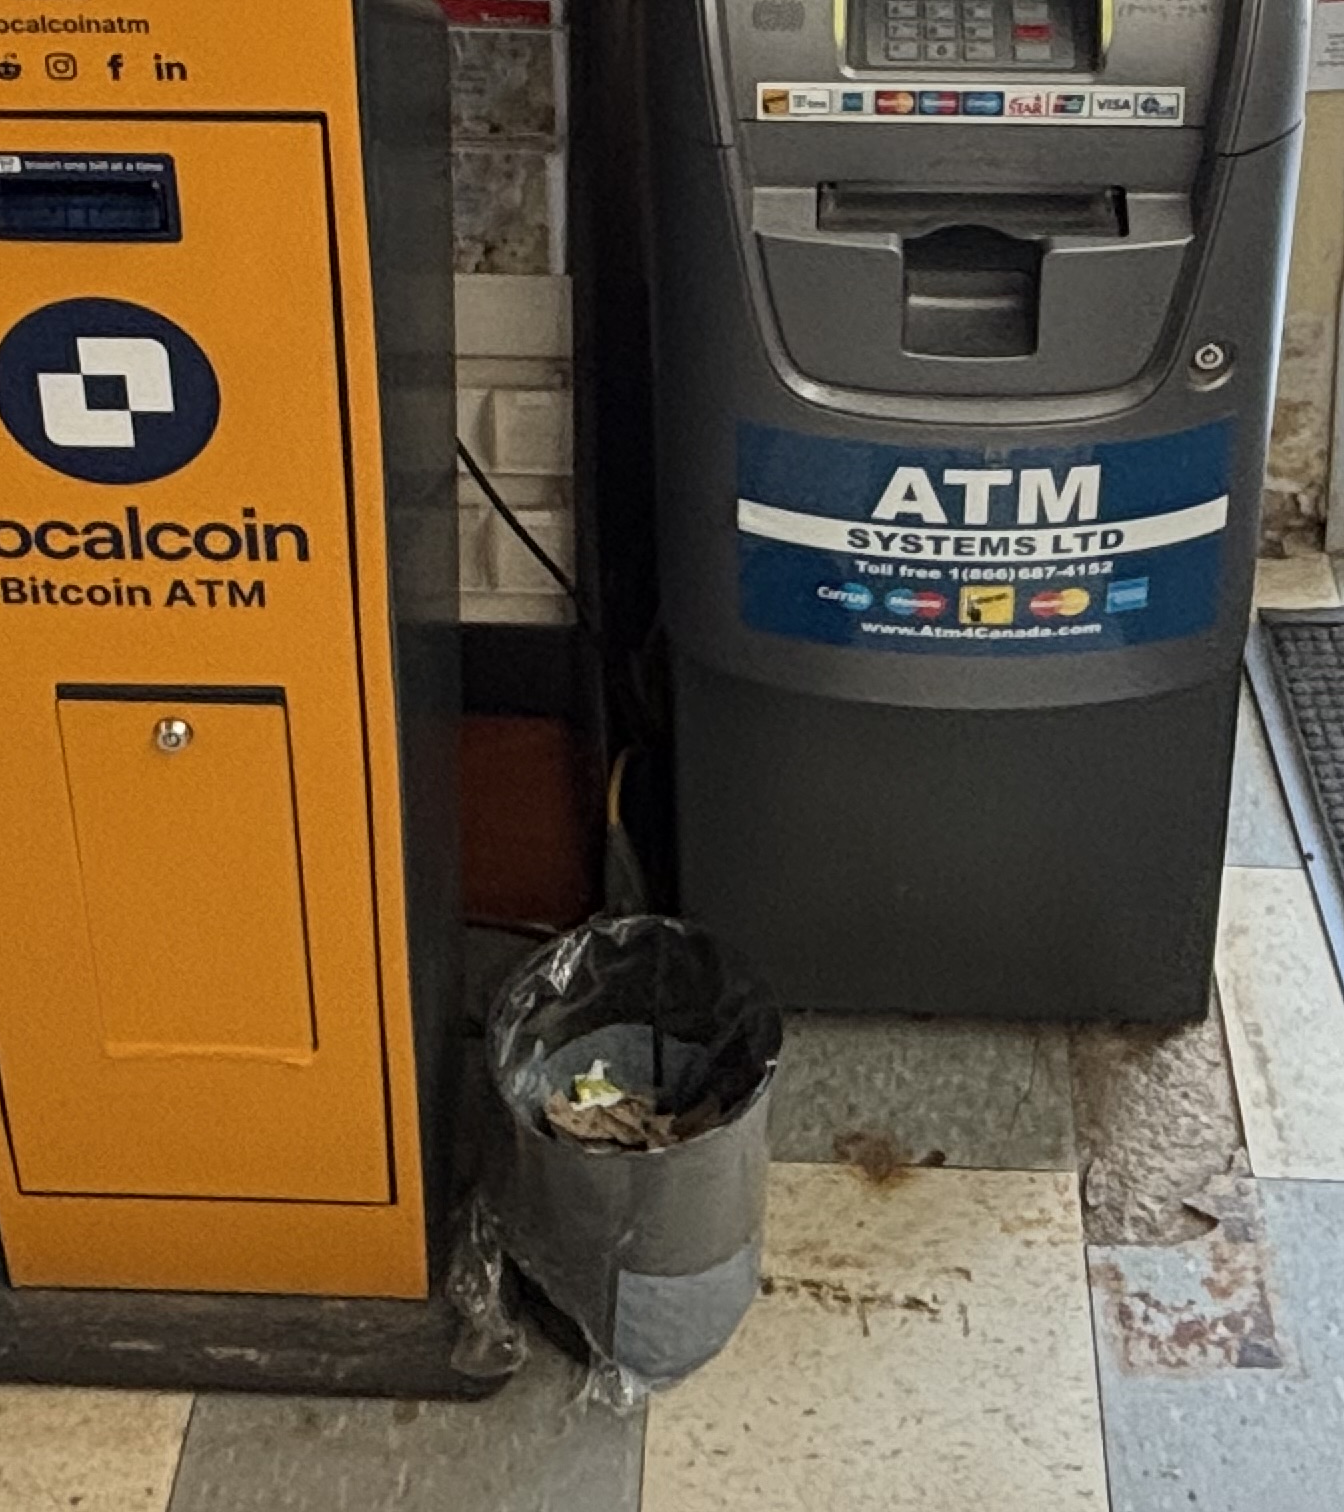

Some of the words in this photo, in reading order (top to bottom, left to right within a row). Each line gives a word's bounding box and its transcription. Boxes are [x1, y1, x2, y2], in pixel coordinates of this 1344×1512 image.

[1096, 98, 1132, 113] VISA
[871, 464, 1102, 526] ATM
[846, 528, 1037, 557] SYSTEMS
[1051, 528, 1125, 555] LTD
[856, 559, 893, 577] Toll
[899, 561, 942, 581] free
[0, 575, 153, 608] Bitcoin
[163, 579, 267, 609] ATM
[816, 585, 870, 605] Cirrus
[859, 620, 1103, 640] www.Atm4Canada.com
